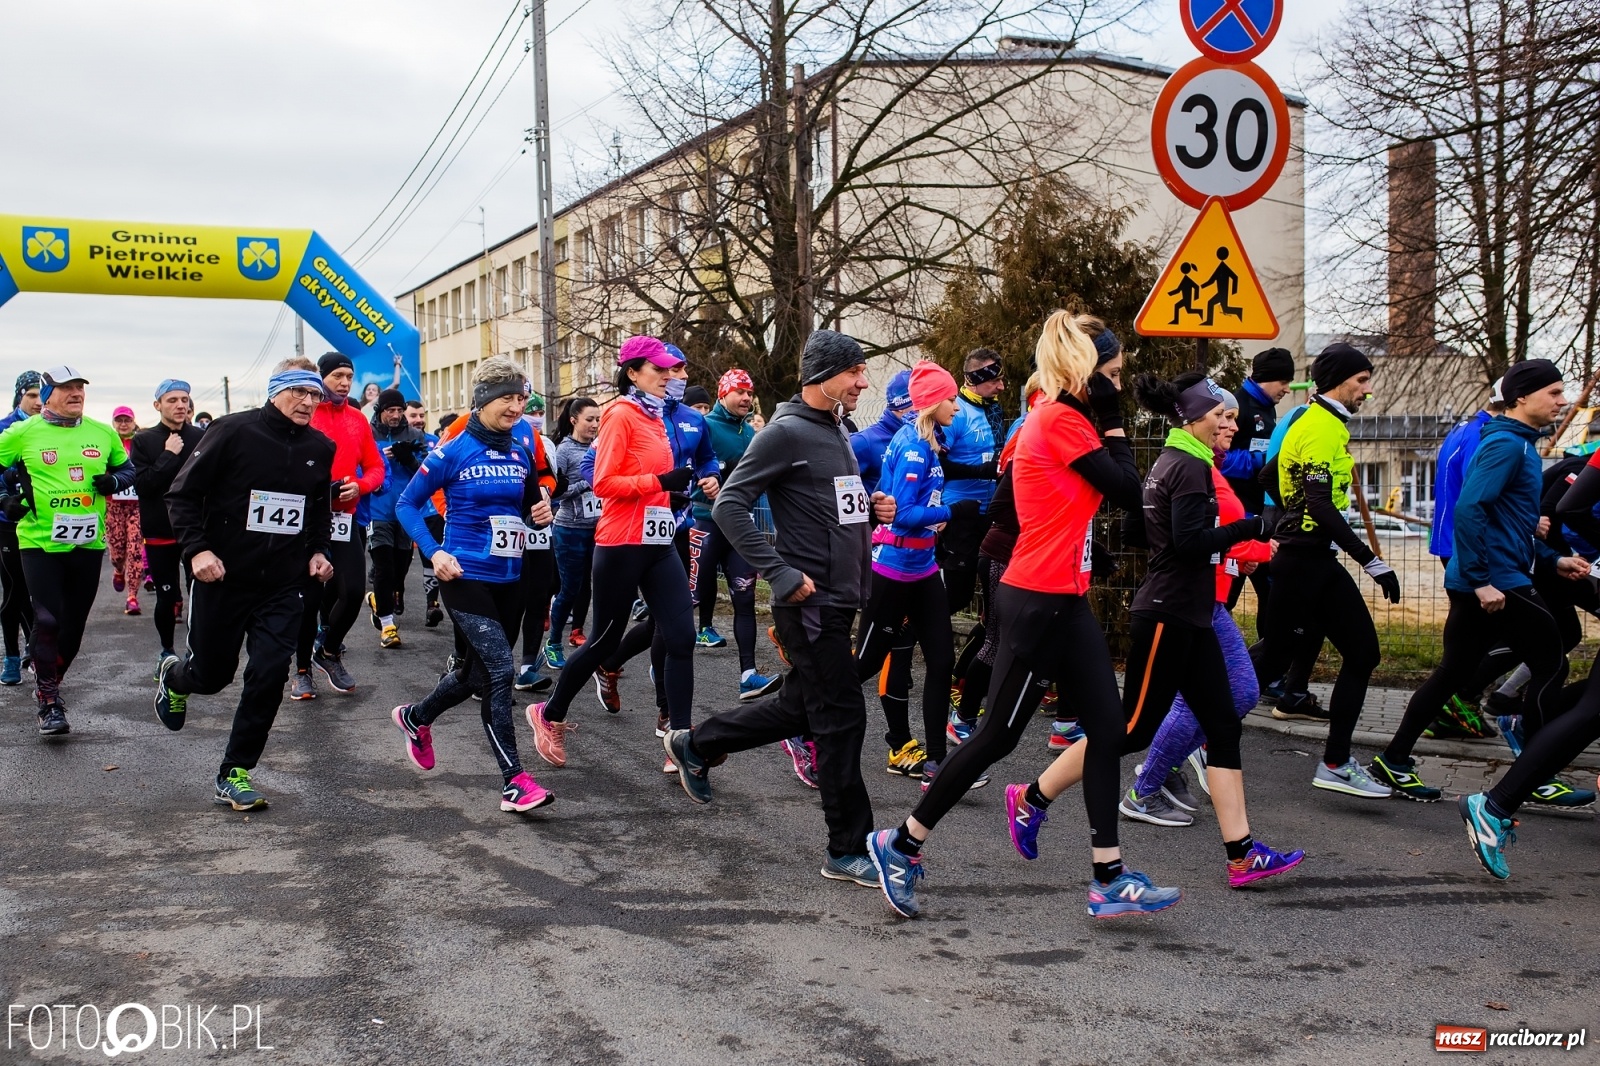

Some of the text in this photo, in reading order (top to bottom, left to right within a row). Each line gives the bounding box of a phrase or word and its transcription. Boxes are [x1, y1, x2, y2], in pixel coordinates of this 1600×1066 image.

[1175, 93, 1269, 172] 30
[111, 230, 197, 246] Gmina
[89, 245, 221, 265] Pietrowice
[107, 264, 204, 282] Wielkie
[311, 255, 395, 335] Gmina ludzi
[299, 273, 377, 347] aktywnych
[253, 505, 300, 527] 142
[54, 525, 95, 539] 275
[645, 520, 674, 538] 360
[495, 530, 525, 551] 370
